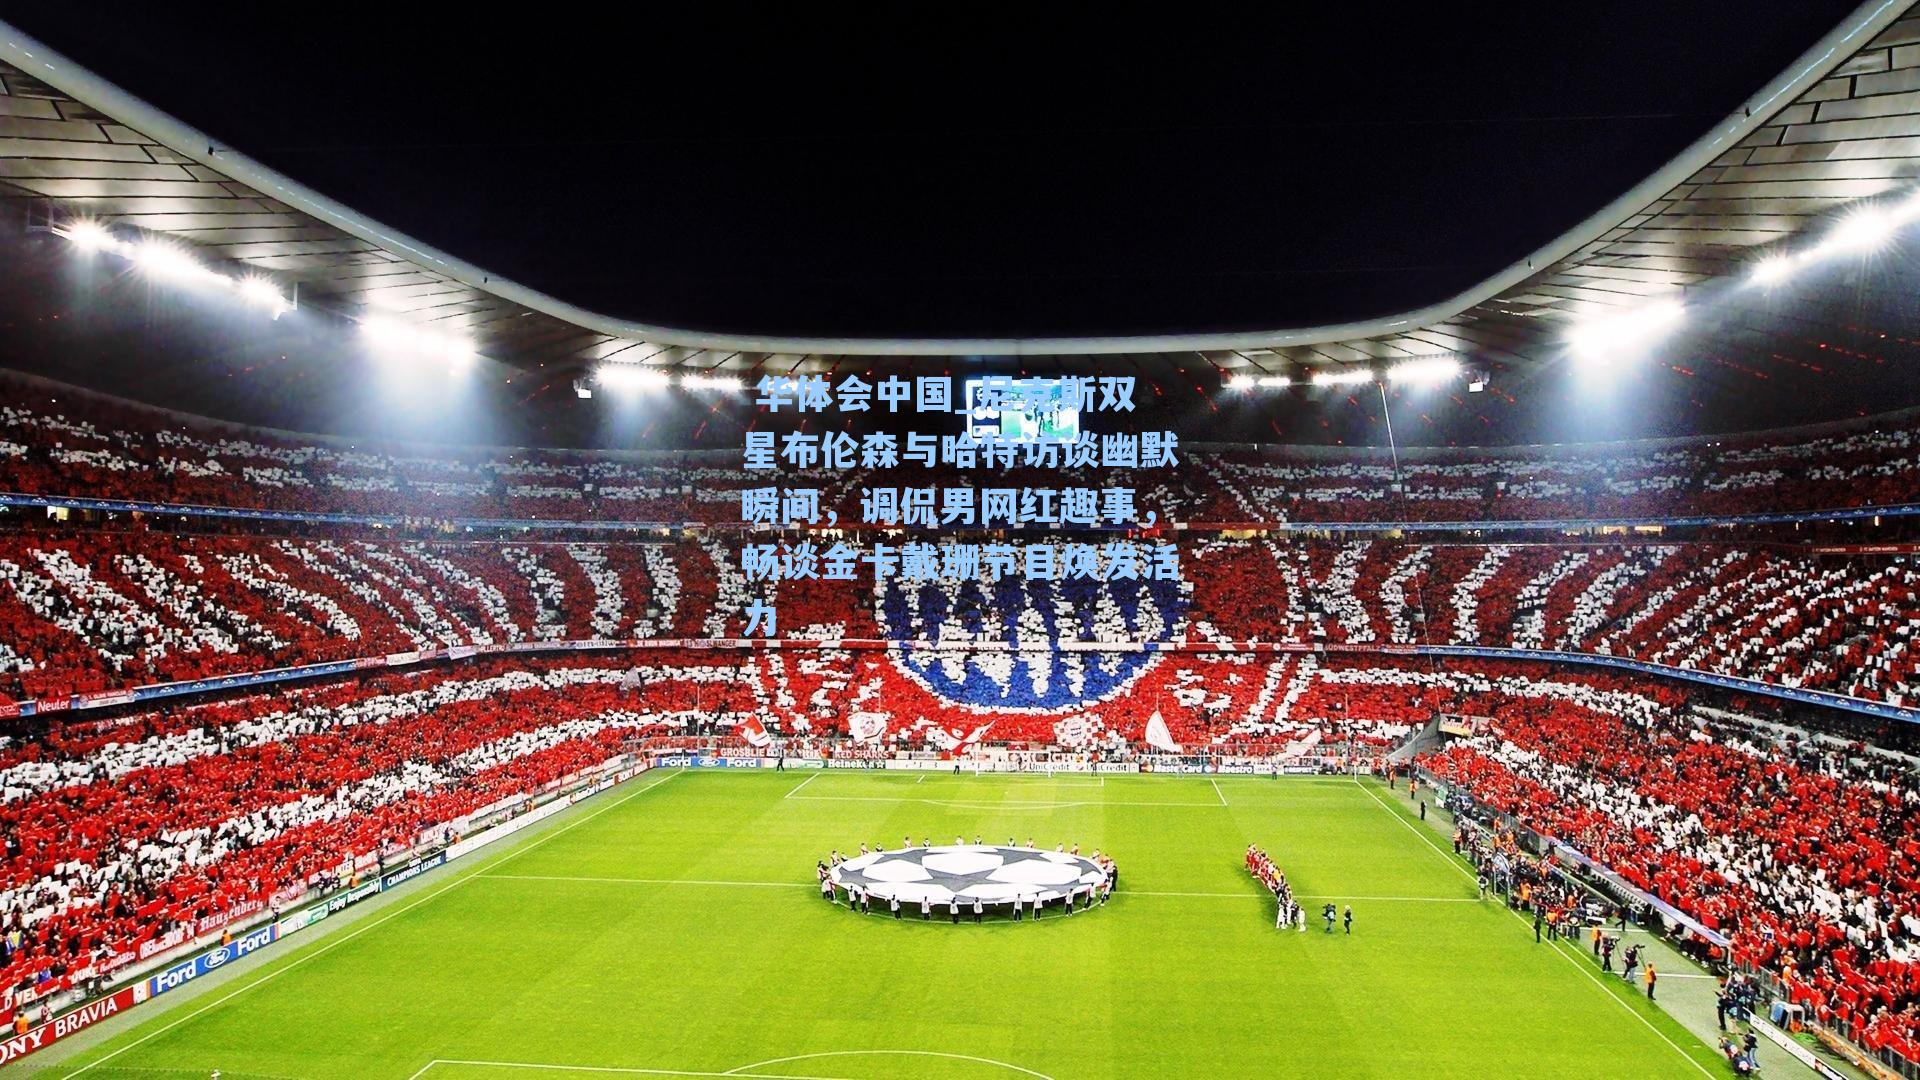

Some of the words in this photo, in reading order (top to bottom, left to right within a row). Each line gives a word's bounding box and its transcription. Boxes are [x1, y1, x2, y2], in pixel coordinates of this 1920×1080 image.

[661, 756, 692, 768] Ford
[726, 757, 757, 768] Ford
[854, 750, 889, 760] SHARKS
[828, 759, 875, 769] Heineken
[387, 865, 421, 887] CHAMPIONS
[421, 855, 442, 871] LEAGUE
[329, 896, 347, 912] Enjoy
[238, 927, 271, 957] Ford
[157, 960, 197, 993] Ford
[55, 996, 118, 1039] BRAVIA
